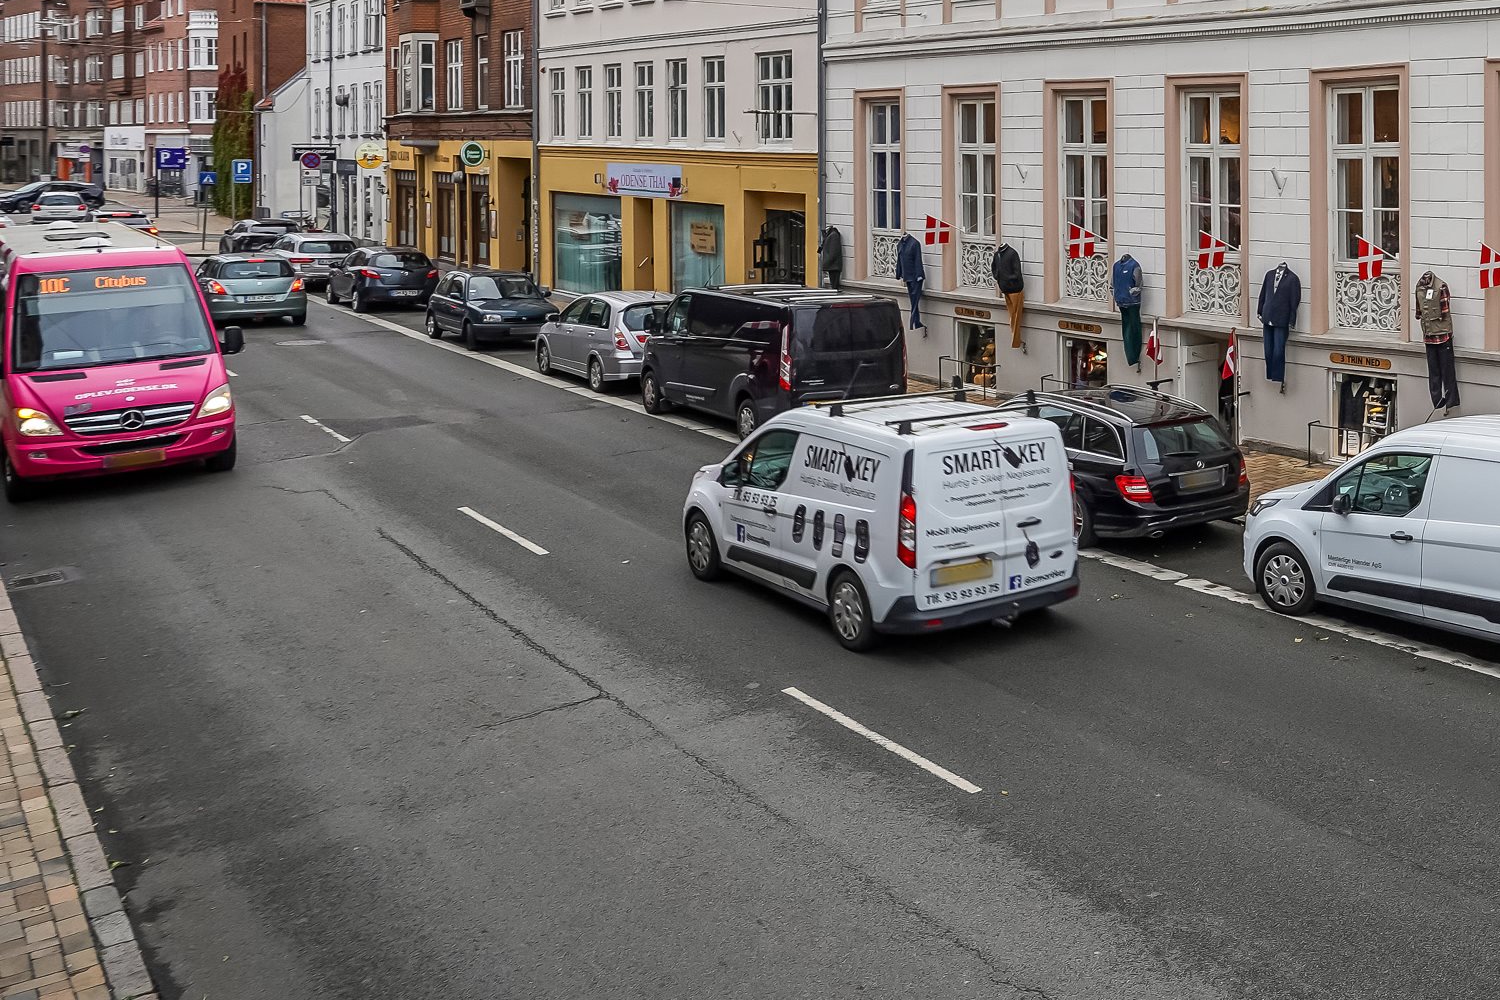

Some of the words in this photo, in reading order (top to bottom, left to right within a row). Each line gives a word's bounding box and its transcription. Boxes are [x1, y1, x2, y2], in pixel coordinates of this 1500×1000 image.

[237, 162, 248, 174] P
[620, 174, 647, 188] ODENSE
[648, 176, 666, 188] THAI
[40, 277, 71, 294] 10C
[95, 275, 147, 289] Citybus
[1340, 354, 1345, 362] 3
[1347, 356, 1363, 364] TRIN
[1366, 358, 1380, 366] NED
[804, 444, 846, 475] SMART
[854, 455, 881, 483] KEY
[943, 448, 1002, 476] SMART
[1018, 442, 1046, 464] KEY
[751, 493, 760, 504] 93
[760, 494, 769, 506] 93
[944, 590, 958, 602] 93
[960, 588, 973, 600] 93
[975, 586, 988, 597] 93
[988, 582, 1000, 594] 75
